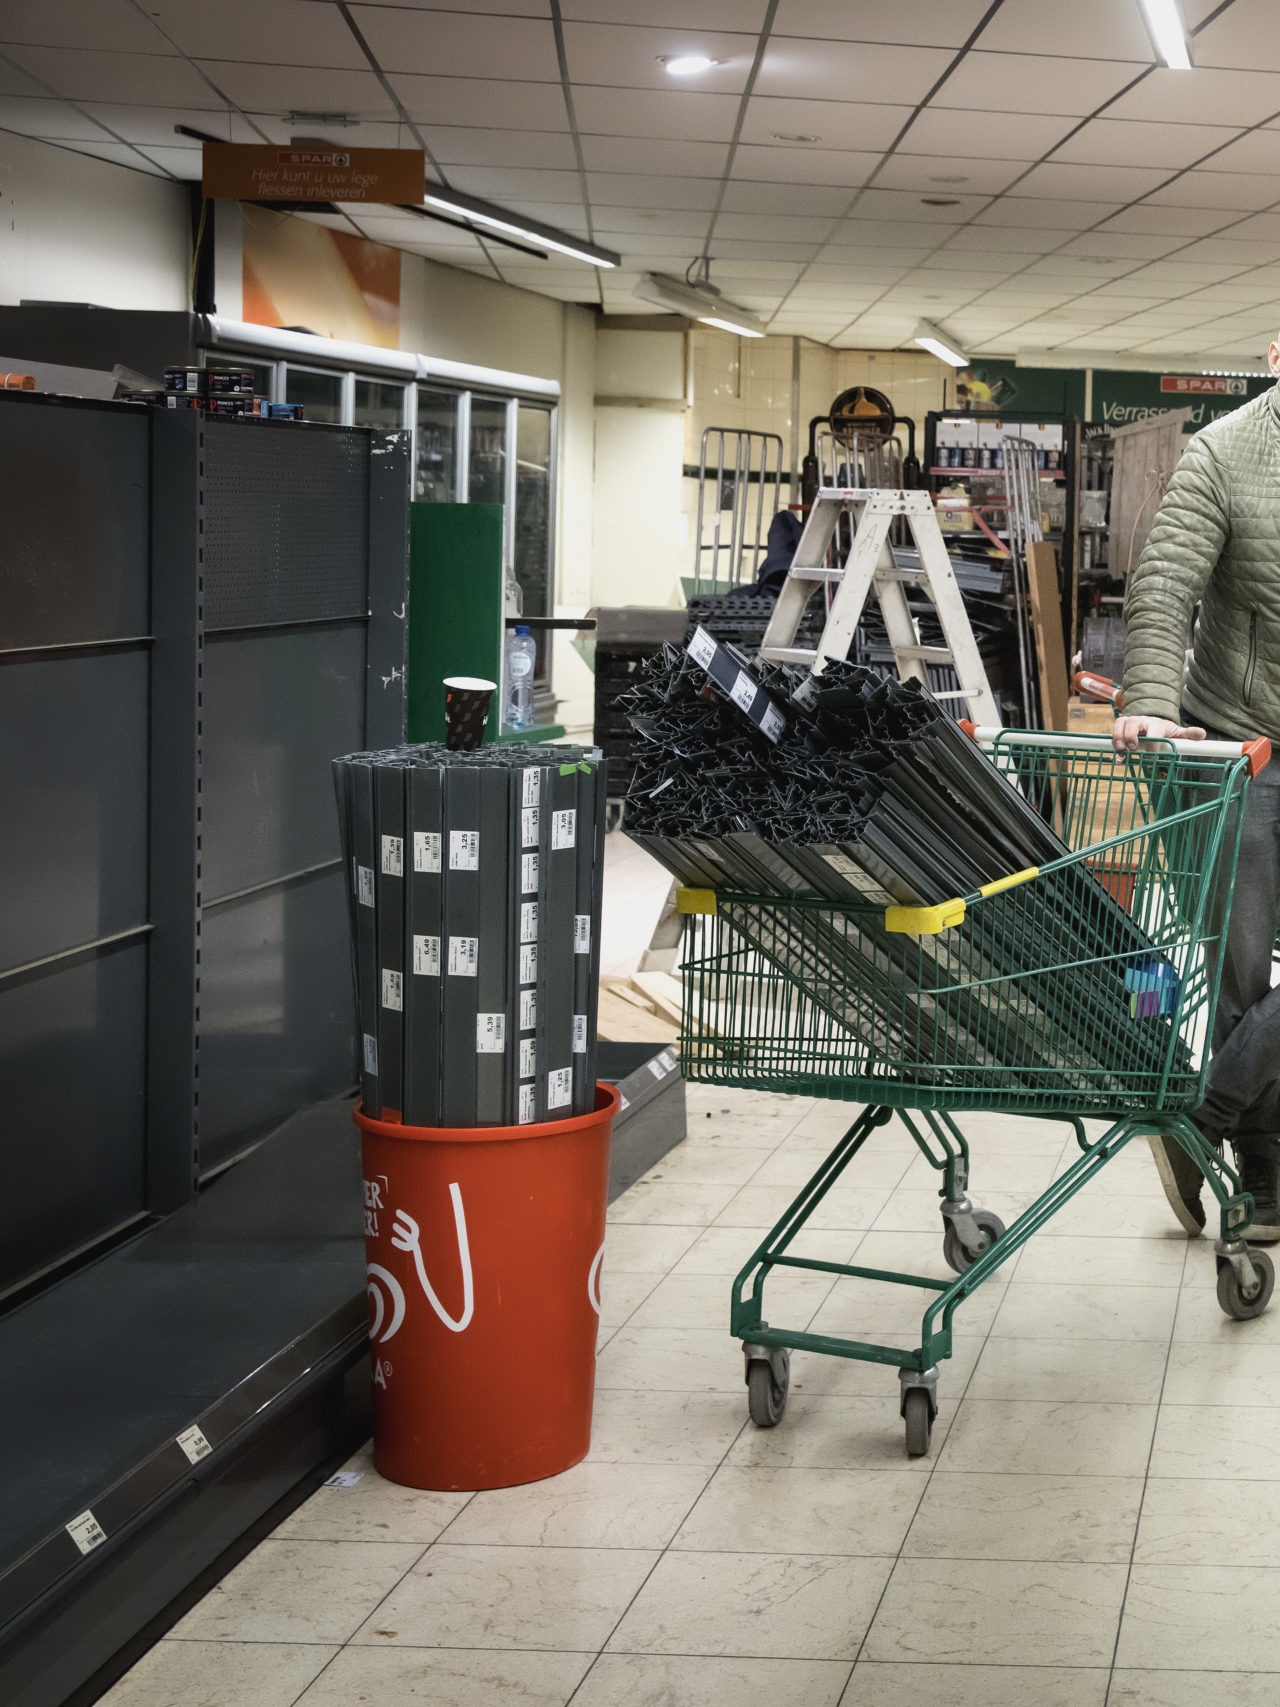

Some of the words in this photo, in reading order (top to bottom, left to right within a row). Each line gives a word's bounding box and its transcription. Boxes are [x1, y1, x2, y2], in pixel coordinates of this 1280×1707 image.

[290, 153, 333, 163] SPAR
[252, 169, 278, 182] Hier
[282, 169, 310, 182] kunt
[315, 174, 324, 183] u
[328, 174, 347, 184] uw
[352, 171, 378, 187] lege
[258, 183, 303, 196] flessen
[306, 184, 365, 198] inleveren
[1176, 379, 1226, 391] SPAR
[1102, 401, 1205, 423] Verrassd
[85, 1522, 98, 1535] 2,05
